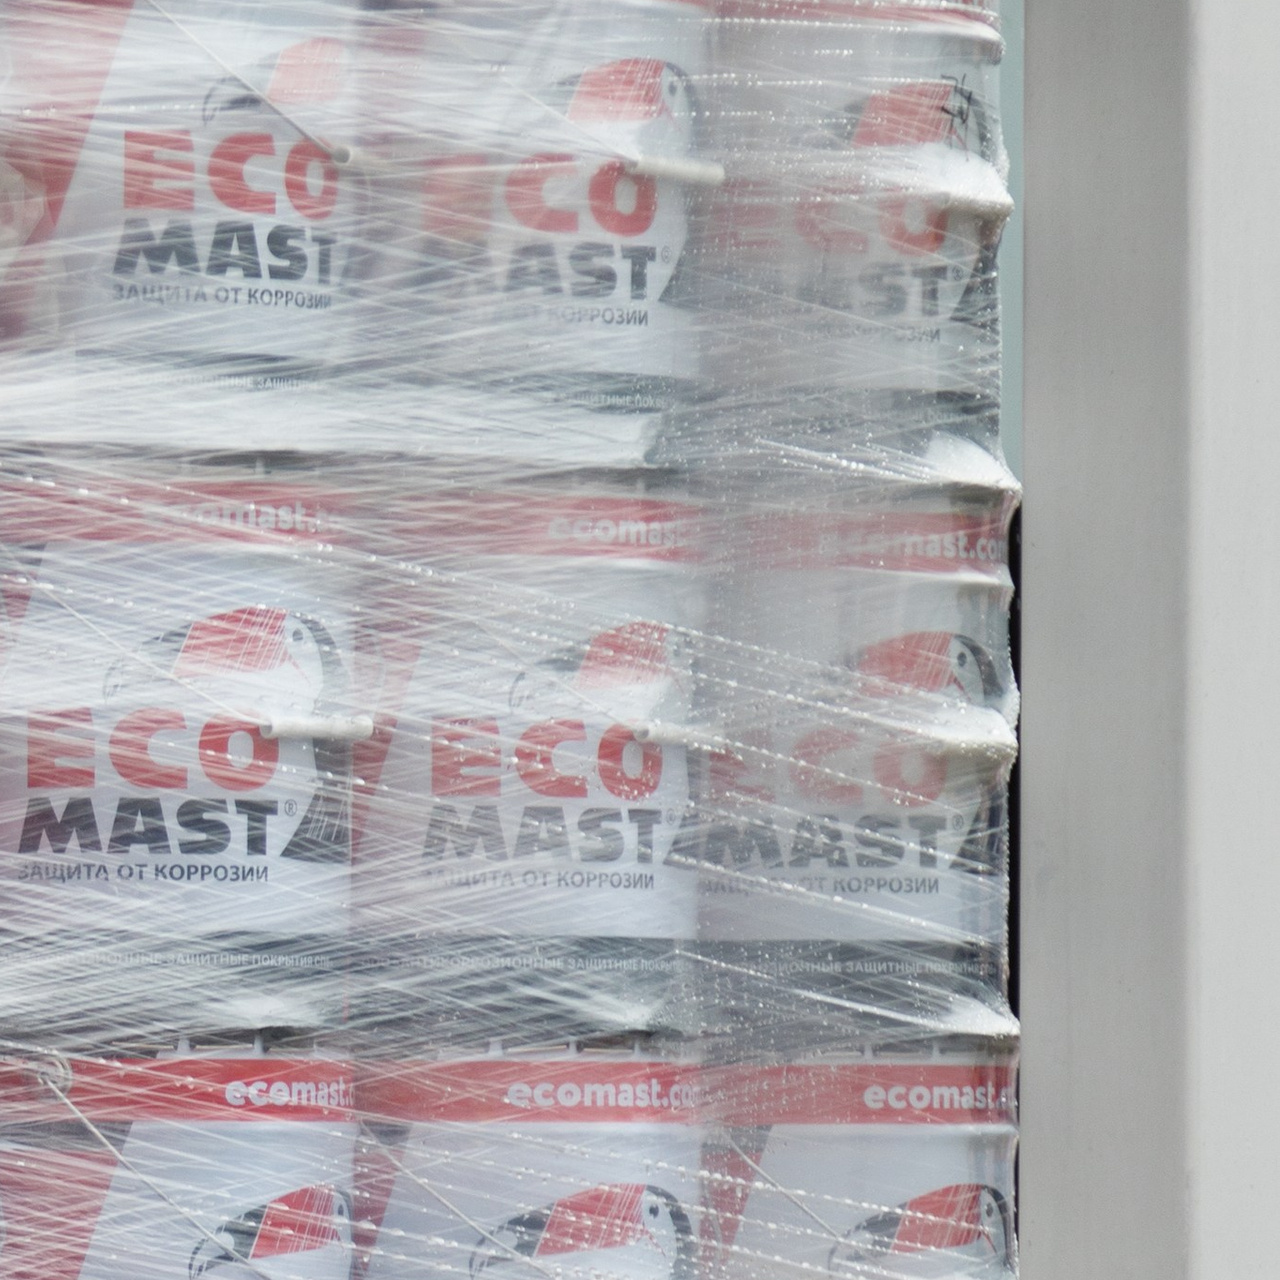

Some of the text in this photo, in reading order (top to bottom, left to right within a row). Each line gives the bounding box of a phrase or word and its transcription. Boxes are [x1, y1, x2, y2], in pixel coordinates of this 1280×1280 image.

[124, 130, 339, 220] ECO
[112, 218, 340, 285] MAST
[215, 287, 242, 305] ОТ
[247, 288, 332, 310] КОРРОЗИИ
[27, 707, 280, 792] ECO
[431, 718, 663, 801] ECO
[18, 797, 278, 856] MAST
[420, 805, 662, 865] MAST
[117, 863, 146, 882] ОТ
[155, 864, 269, 882] КОРРОЗИИ
[557, 871, 655, 890] КОРРОЗИИ
[833, 877, 939, 895] КОРРОЗИИ
